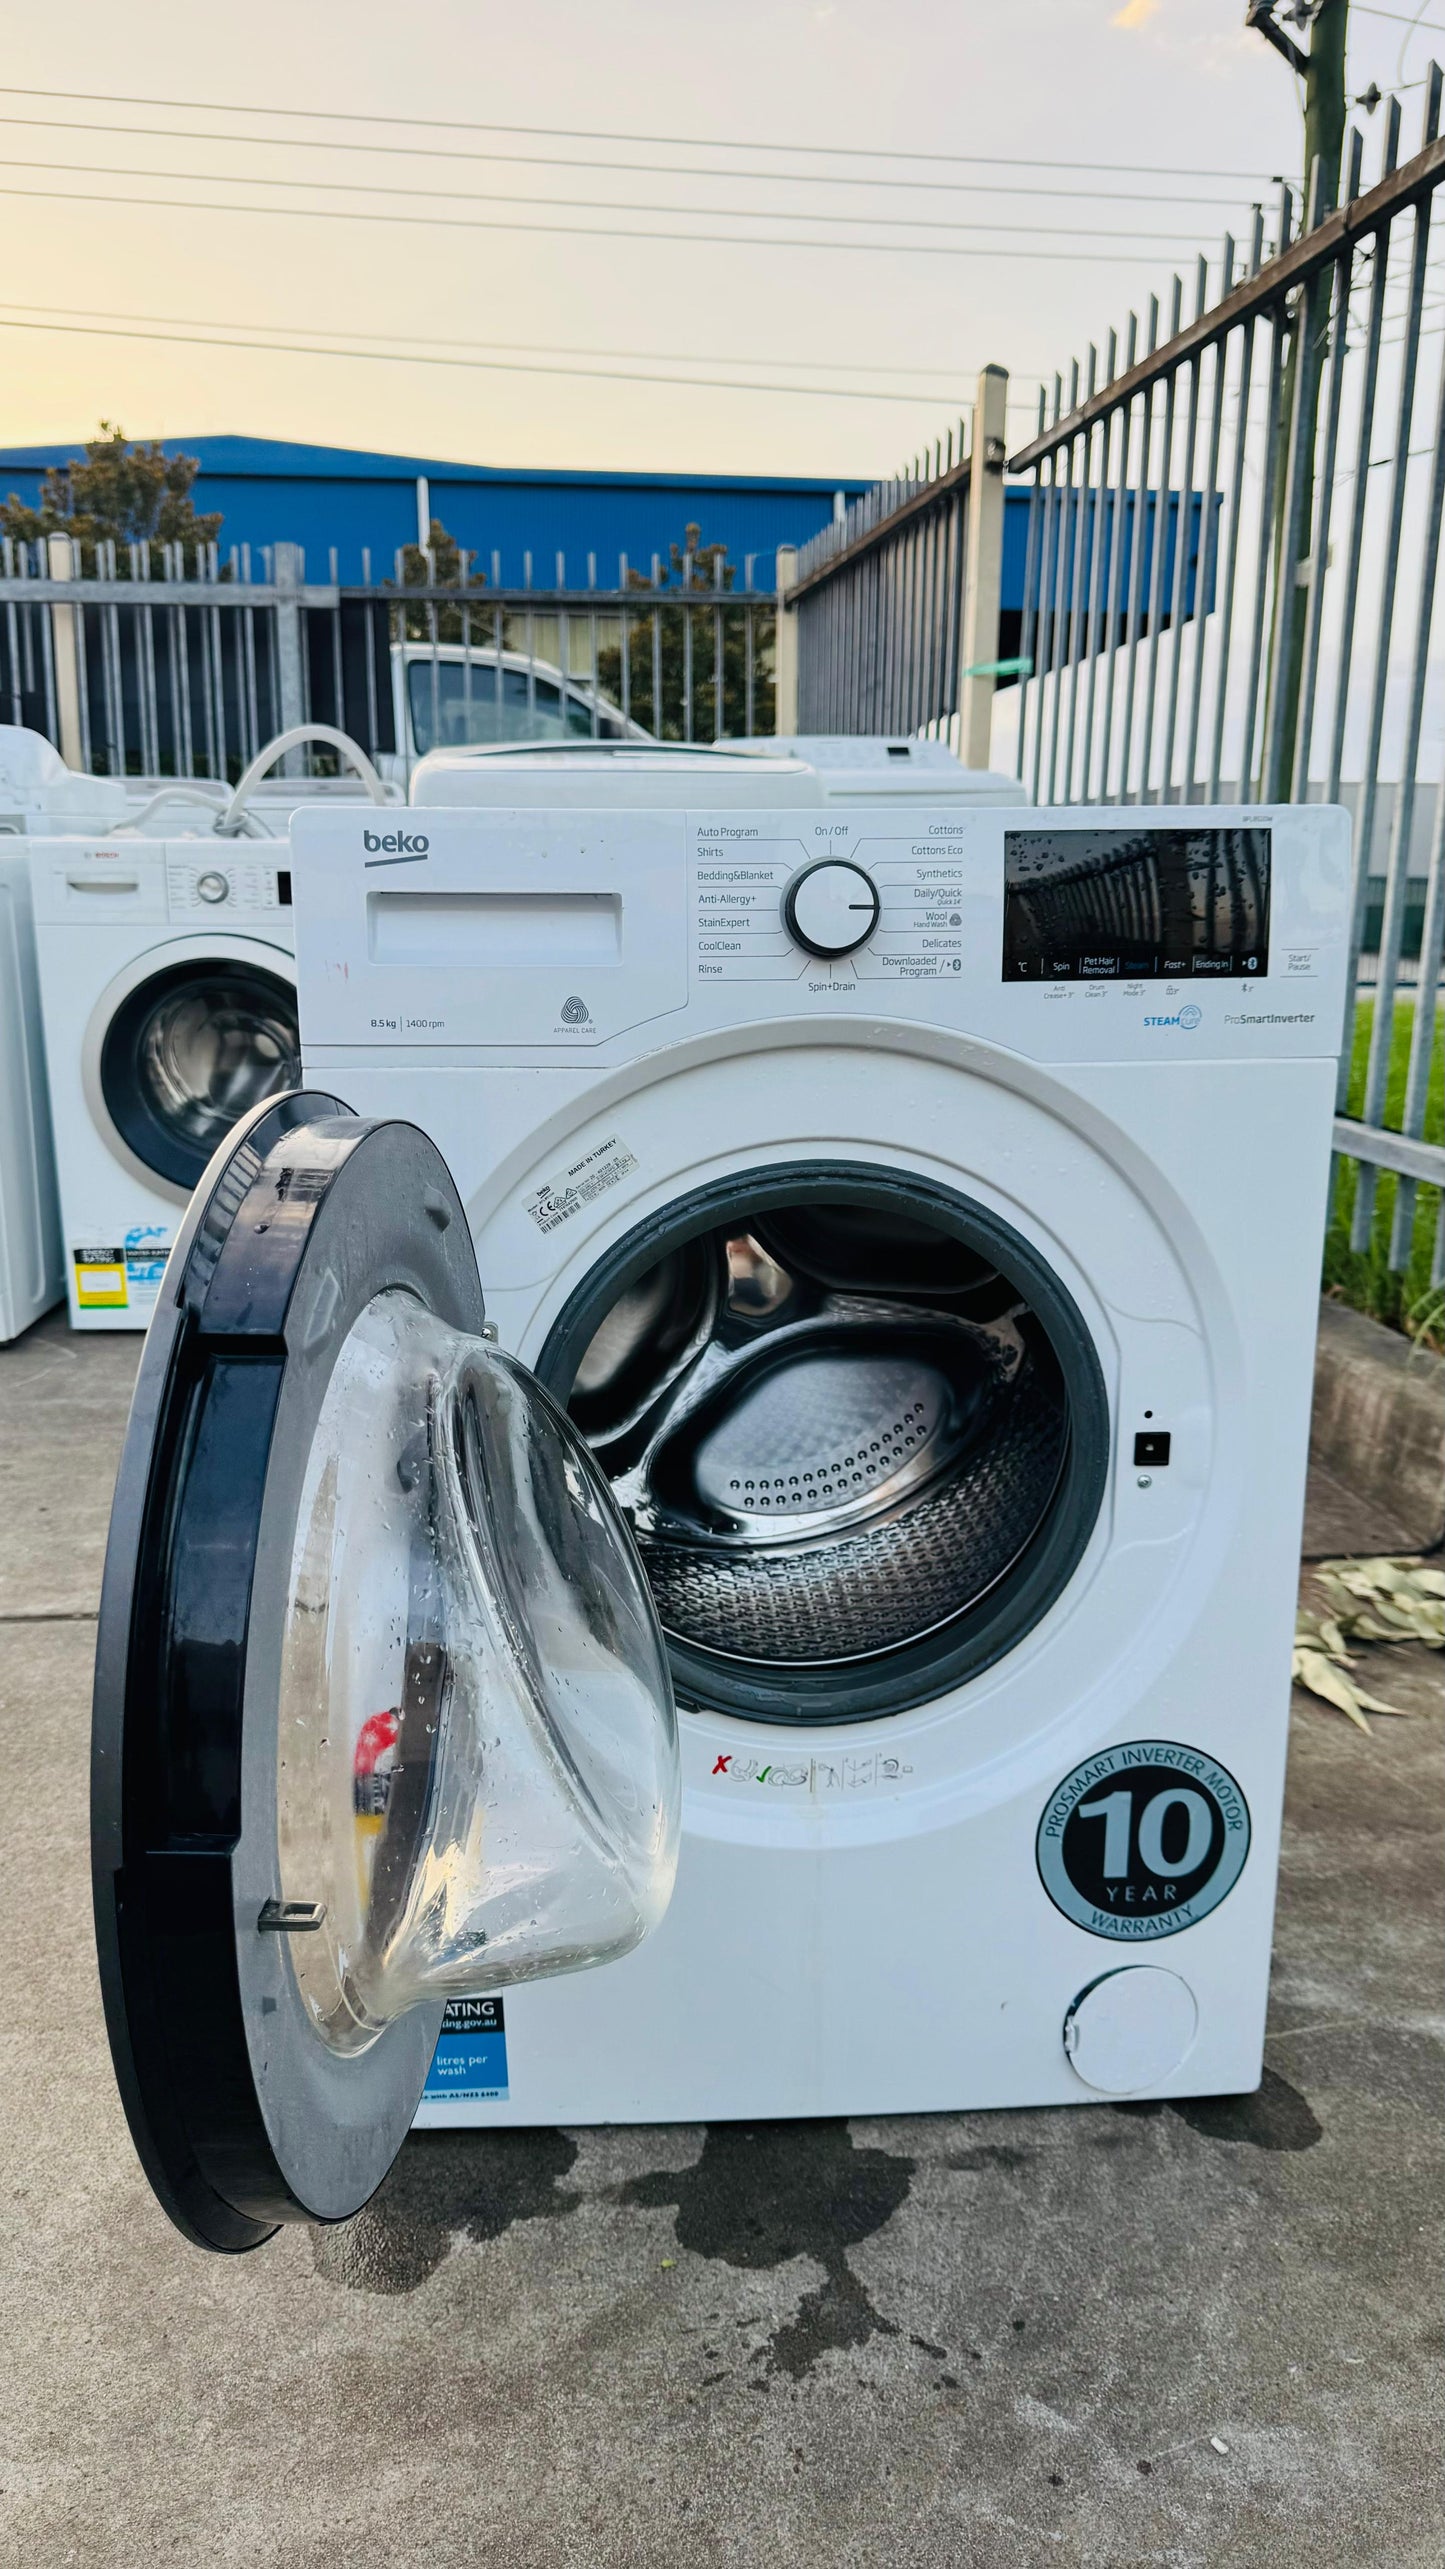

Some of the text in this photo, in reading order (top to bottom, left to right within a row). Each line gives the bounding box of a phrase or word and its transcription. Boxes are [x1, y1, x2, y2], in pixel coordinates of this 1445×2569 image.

[697, 828, 758, 838] Auto Program
[814, 827, 828, 836] On
[834, 826, 848, 836] Off
[928, 826, 964, 835] Cottons
[364, 830, 430, 853] beko
[697, 848, 724, 857] Shirts
[912, 846, 963, 856] Cottons Eco
[698, 871, 774, 882] Bedding&Blanket
[916, 869, 963, 880] Synthetics
[914, 888, 962, 899] Daily/Quick
[698, 894, 757, 905] Anti-Allergy+
[926, 912, 948, 922] Wool
[698, 918, 750, 929] StainExpert
[698, 941, 741, 951] CoolClean
[922, 939, 962, 949] Delicates
[882, 957, 937, 966] Downloaded
[1084, 956, 1115, 965] Pet Hair
[1164, 960, 1186, 968] Fast+
[1195, 960, 1220, 970] Ending
[698, 964, 722, 974] Rinse
[1053, 962, 1070, 972] Spin
[1082, 966, 1116, 974] Removal
[1288, 962, 1311, 970] Pause
[900, 967, 937, 978] Program
[808, 982, 856, 994] Spin+Drain
[1224, 1014, 1316, 1024] ProSmartInverter
[370, 1018, 445, 1031] 8.5 kg 1400 rpm
[568, 1160, 586, 1176] MADE
[593, 1138, 617, 1158] TURKEY
[536, 1186, 551, 1196] beko
[1046, 1748, 1243, 1838] PROSMART INVERTER MOTOR
[1078, 1788, 1213, 1878] 10
[1106, 1884, 1178, 1902] YEAR
[1092, 1904, 1194, 1934] WARRANTY
[446, 2002, 494, 2016] ATING
[436, 2056, 488, 2066] litres per
[438, 2066, 466, 2076] wash
